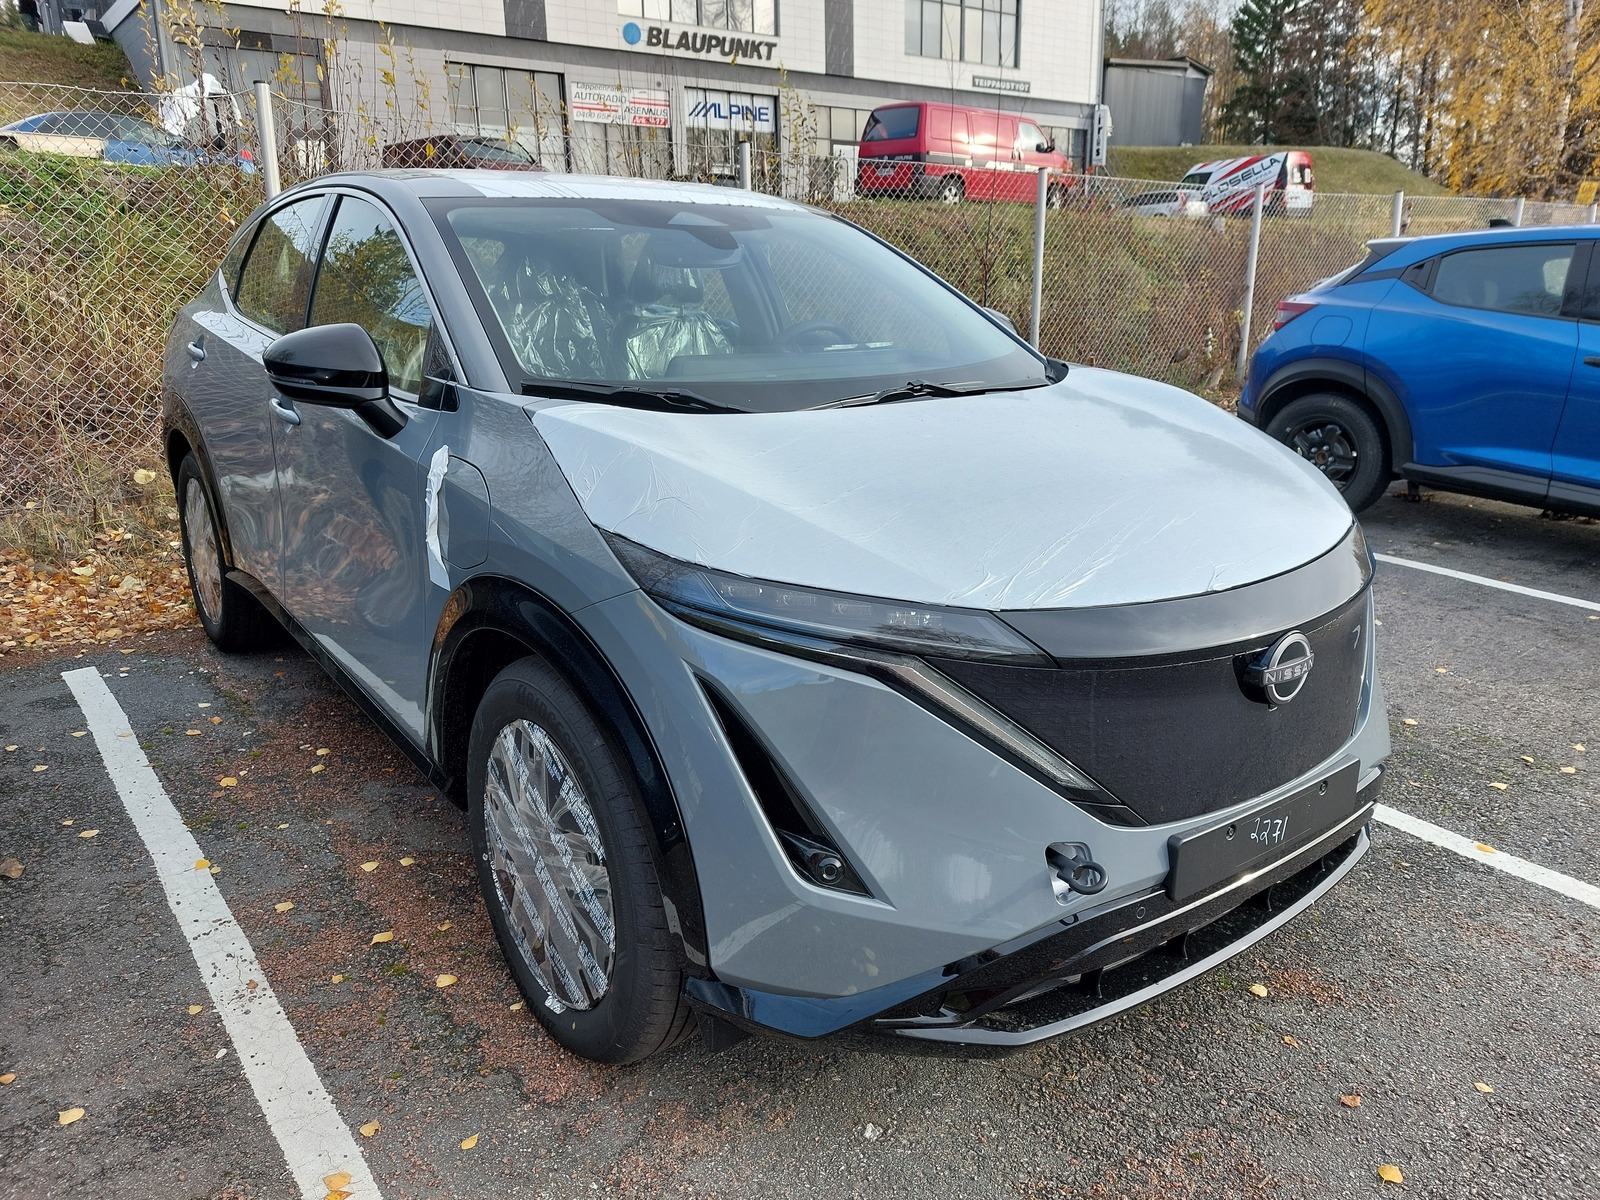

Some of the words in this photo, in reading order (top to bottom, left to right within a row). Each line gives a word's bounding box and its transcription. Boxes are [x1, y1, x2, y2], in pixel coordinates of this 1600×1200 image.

[646, 26, 777, 60] BLAUPUNKT
[574, 91, 627, 104] AUTORADIO
[624, 105, 668, 117] ASENNUS
[701, 102, 770, 122] ALPINE
[1265, 659, 1313, 683] NISSAN
[1250, 815, 1289, 846] 2271
